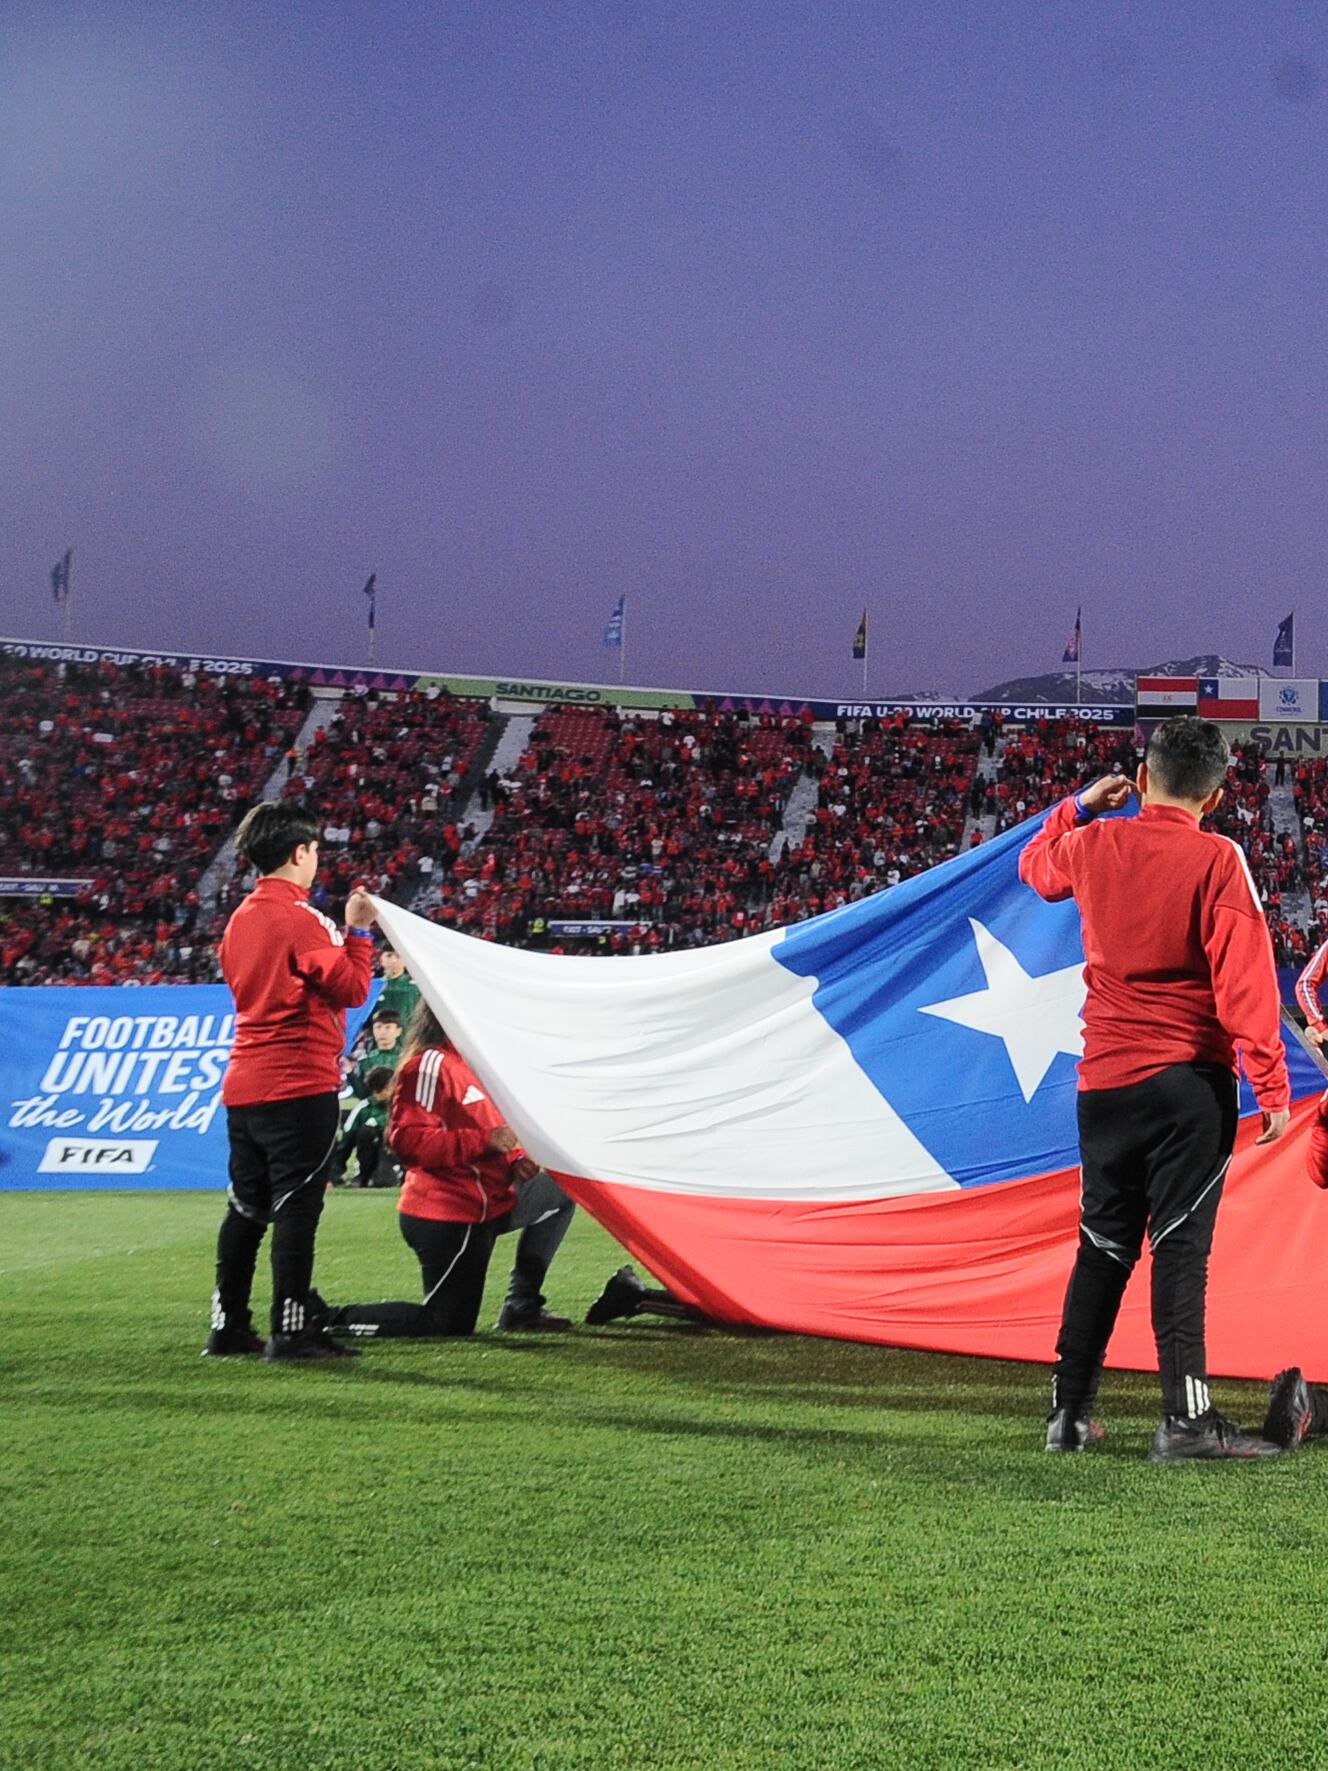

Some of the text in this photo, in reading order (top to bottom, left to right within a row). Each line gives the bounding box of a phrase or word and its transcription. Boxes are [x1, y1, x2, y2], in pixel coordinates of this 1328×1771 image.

[29, 646, 99, 663] WORLD
[202, 660, 253, 675] 2025
[496, 682, 601, 702] SANTIAGO
[837, 705, 872, 717] FIFA
[916, 707, 975, 718] WORLD
[59, 1016, 235, 1049] FOOTBALL
[40, 1050, 230, 1095] UNITES
[8, 1091, 226, 1134] the World
[60, 1146, 136, 1164] FIFA
